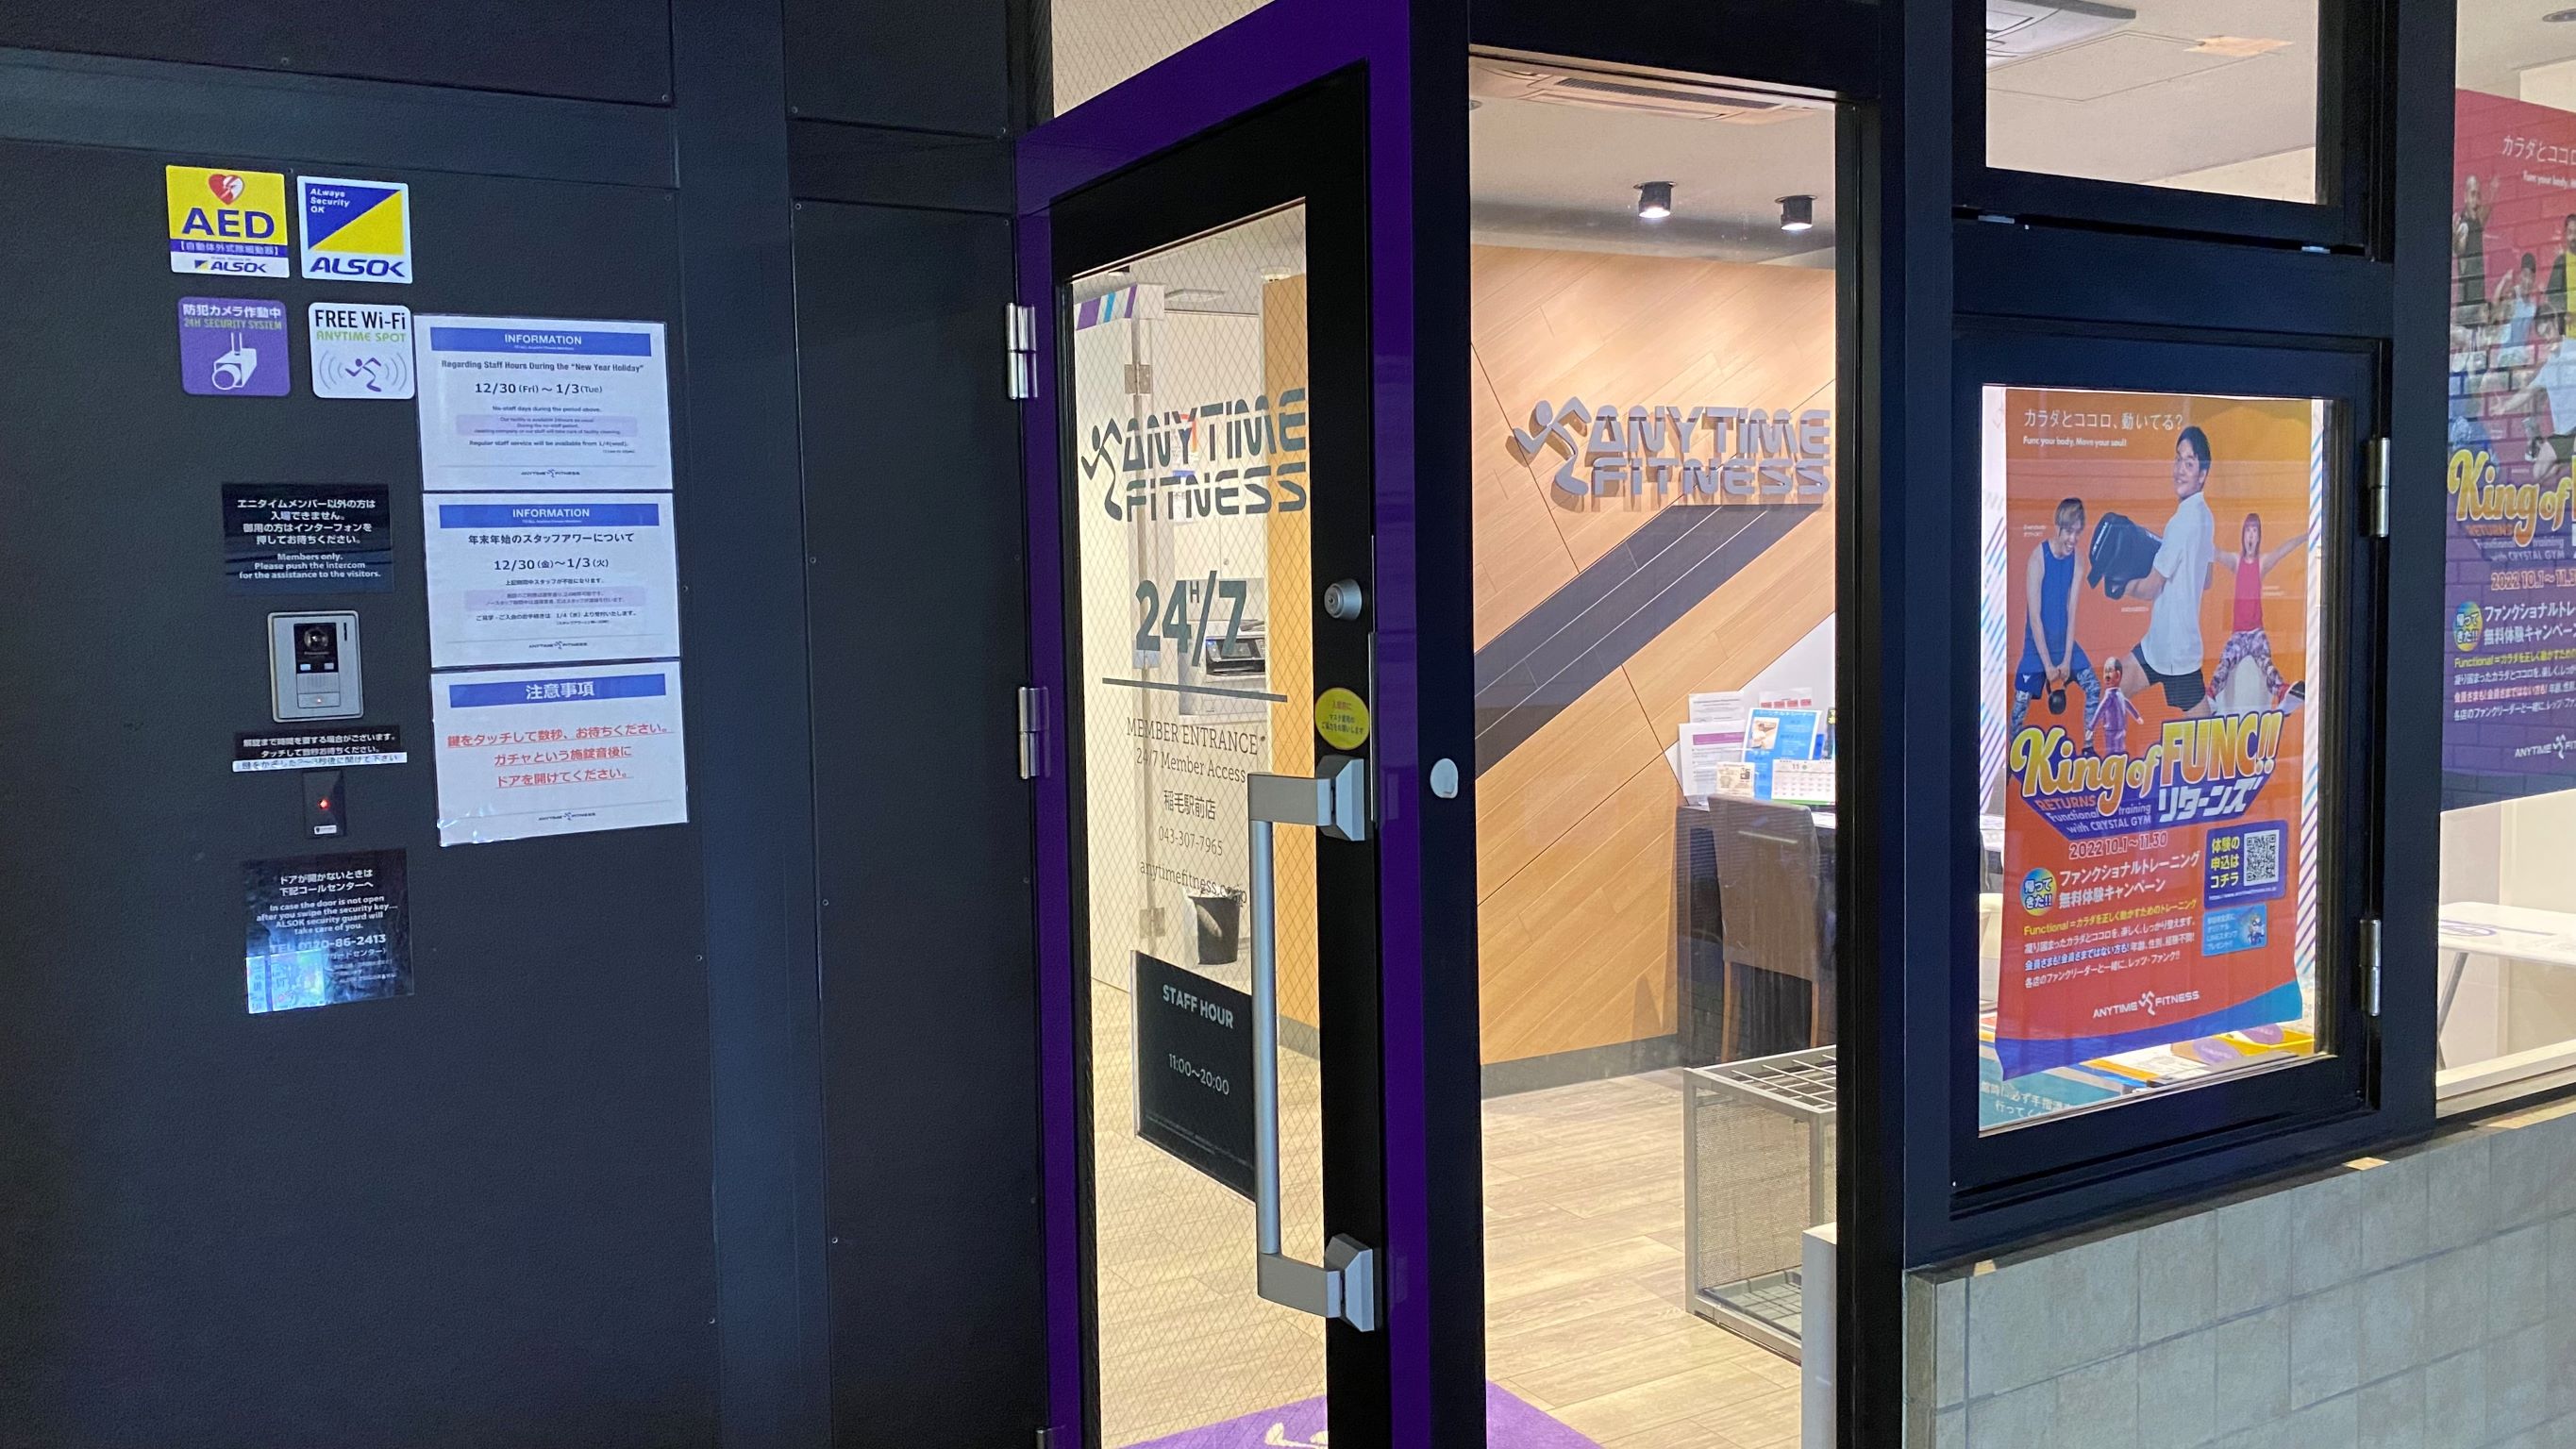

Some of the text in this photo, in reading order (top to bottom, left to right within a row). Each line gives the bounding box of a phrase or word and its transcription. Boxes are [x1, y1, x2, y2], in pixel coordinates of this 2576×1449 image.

[310, 196, 350, 208] Security
[181, 208, 275, 239] AED
[210, 261, 268, 273] ALSOK
[309, 257, 405, 277] ALSOK
[183, 304, 281, 319] 防犯カメラ作動中
[315, 309, 407, 329] FREE Wi-Fi
[205, 319, 247, 329] SECURITY
[248, 320, 282, 330] SYSTEM
[316, 330, 407, 342] ANYTIME SPOT
[504, 333, 581, 345] INFORMATION
[442, 360, 482, 370] Regarding
[484, 360, 503, 369] Staff
[505, 361, 527, 370] Hours
[529, 362, 554, 371] During
[475, 383, 516, 394] 12/30
[2024, 408, 2183, 430] カラダとココロ、動いてる?
[1122, 387, 1306, 472] ANYTIME
[1586, 405, 1831, 454] ANYTIME
[1591, 457, 1831, 495] FITNESS
[1127, 462, 1307, 522] FITNESS
[2448, 448, 2572, 548] King of
[237, 499, 376, 508] エニタイムメンバー以外の方は
[512, 508, 590, 518] INFORMATION
[468, 532, 635, 545] 年末年始のスタッフアワーについて
[277, 553, 343, 562] Members only.
[2544, 550, 2566, 559] GYM
[271, 571, 318, 579] assistance
[286, 562, 308, 572] push
[2491, 572, 2520, 591] 2022
[526, 681, 594, 701] 注意事項
[1127, 717, 1258, 755] MEMBER ENTRANCE
[2515, 743, 2551, 758] ANYTIME
[1136, 747, 1246, 783] 24/7 Member Access
[2009, 710, 2283, 817] King of FUNC!!
[497, 769, 628, 788] ドアを開けてください。
[1163, 790, 1216, 821] 稲毛駅前店
[2034, 795, 2097, 811] RETURNS
[2158, 775, 2264, 823] リターンズ
[2045, 804, 2151, 824] Functional training
[2066, 815, 2151, 834] with CRYSTAL GYM
[1159, 825, 1223, 857] 043-307-7965
[2068, 841, 2102, 859] 2022
[2212, 836, 2240, 854] 体験の
[2060, 853, 2200, 887] ファンクショナルトレーニング
[2210, 854, 2239, 871] 申込は
[2210, 872, 2239, 889] コチラ
[2059, 878, 2166, 909] 無料体験キャンペーン
[280, 903, 299, 911] case
[301, 901, 314, 909] the
[363, 895, 385, 905] open
[257, 913, 277, 922] after
[297, 909, 322, 919] swipe
[340, 905, 372, 914] security
[307, 916, 340, 925] security
[342, 914, 367, 924] guard
[344, 923, 363, 932] you.
[1163, 984, 1234, 1028] STAFF HOUR
[2093, 991, 2200, 1019] ANYTIME FITNESS
